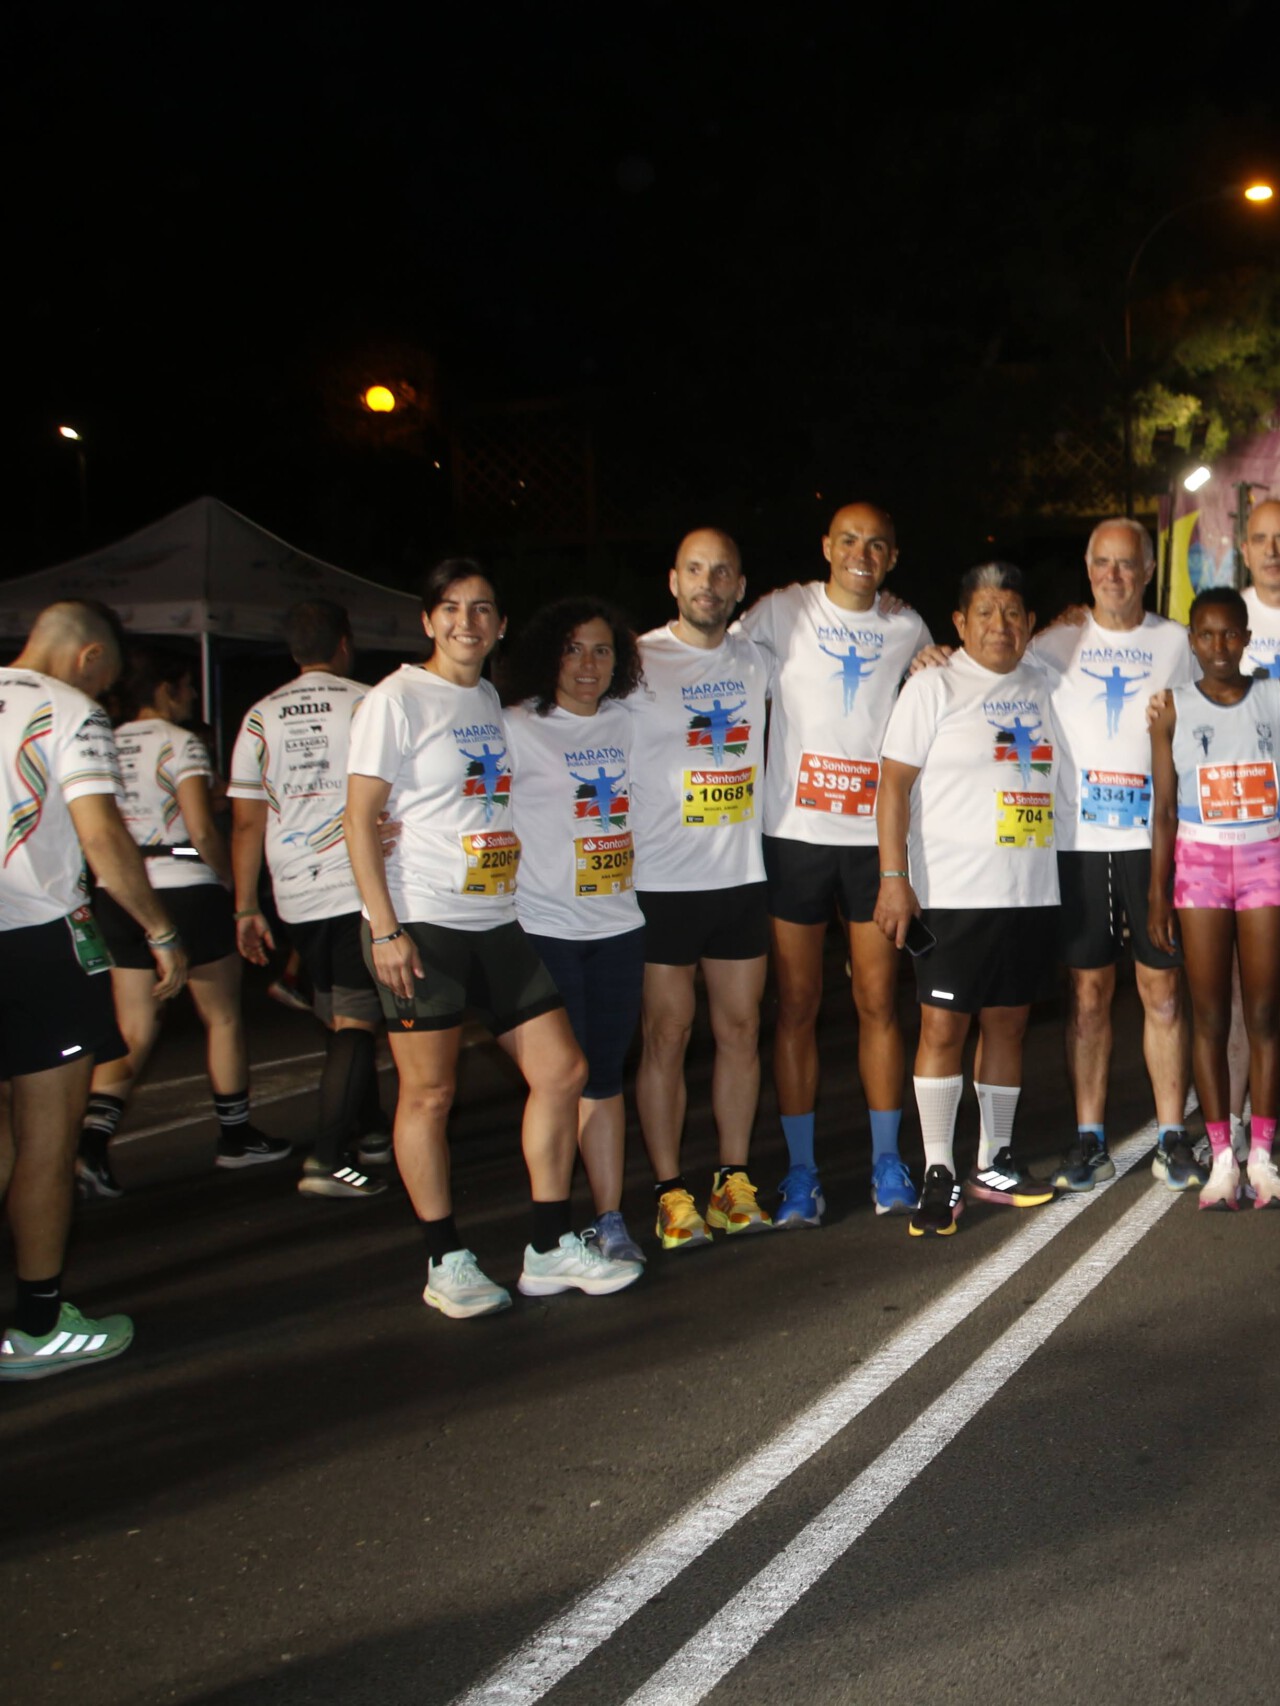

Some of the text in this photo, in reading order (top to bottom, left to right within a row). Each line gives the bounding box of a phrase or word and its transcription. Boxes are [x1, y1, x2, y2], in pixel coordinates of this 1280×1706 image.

[681, 679, 745, 697] MARATÓN
[822, 759, 872, 774] Santander
[705, 772, 751, 784] Santander
[812, 771, 862, 792] 3395
[699, 786, 744, 802] 1068
[1093, 787, 1134, 804] 3341
[1233, 781, 1243, 796] 3
[1016, 809, 1042, 823] 704
[482, 850, 513, 869] 2206
[591, 851, 628, 870] 3205
